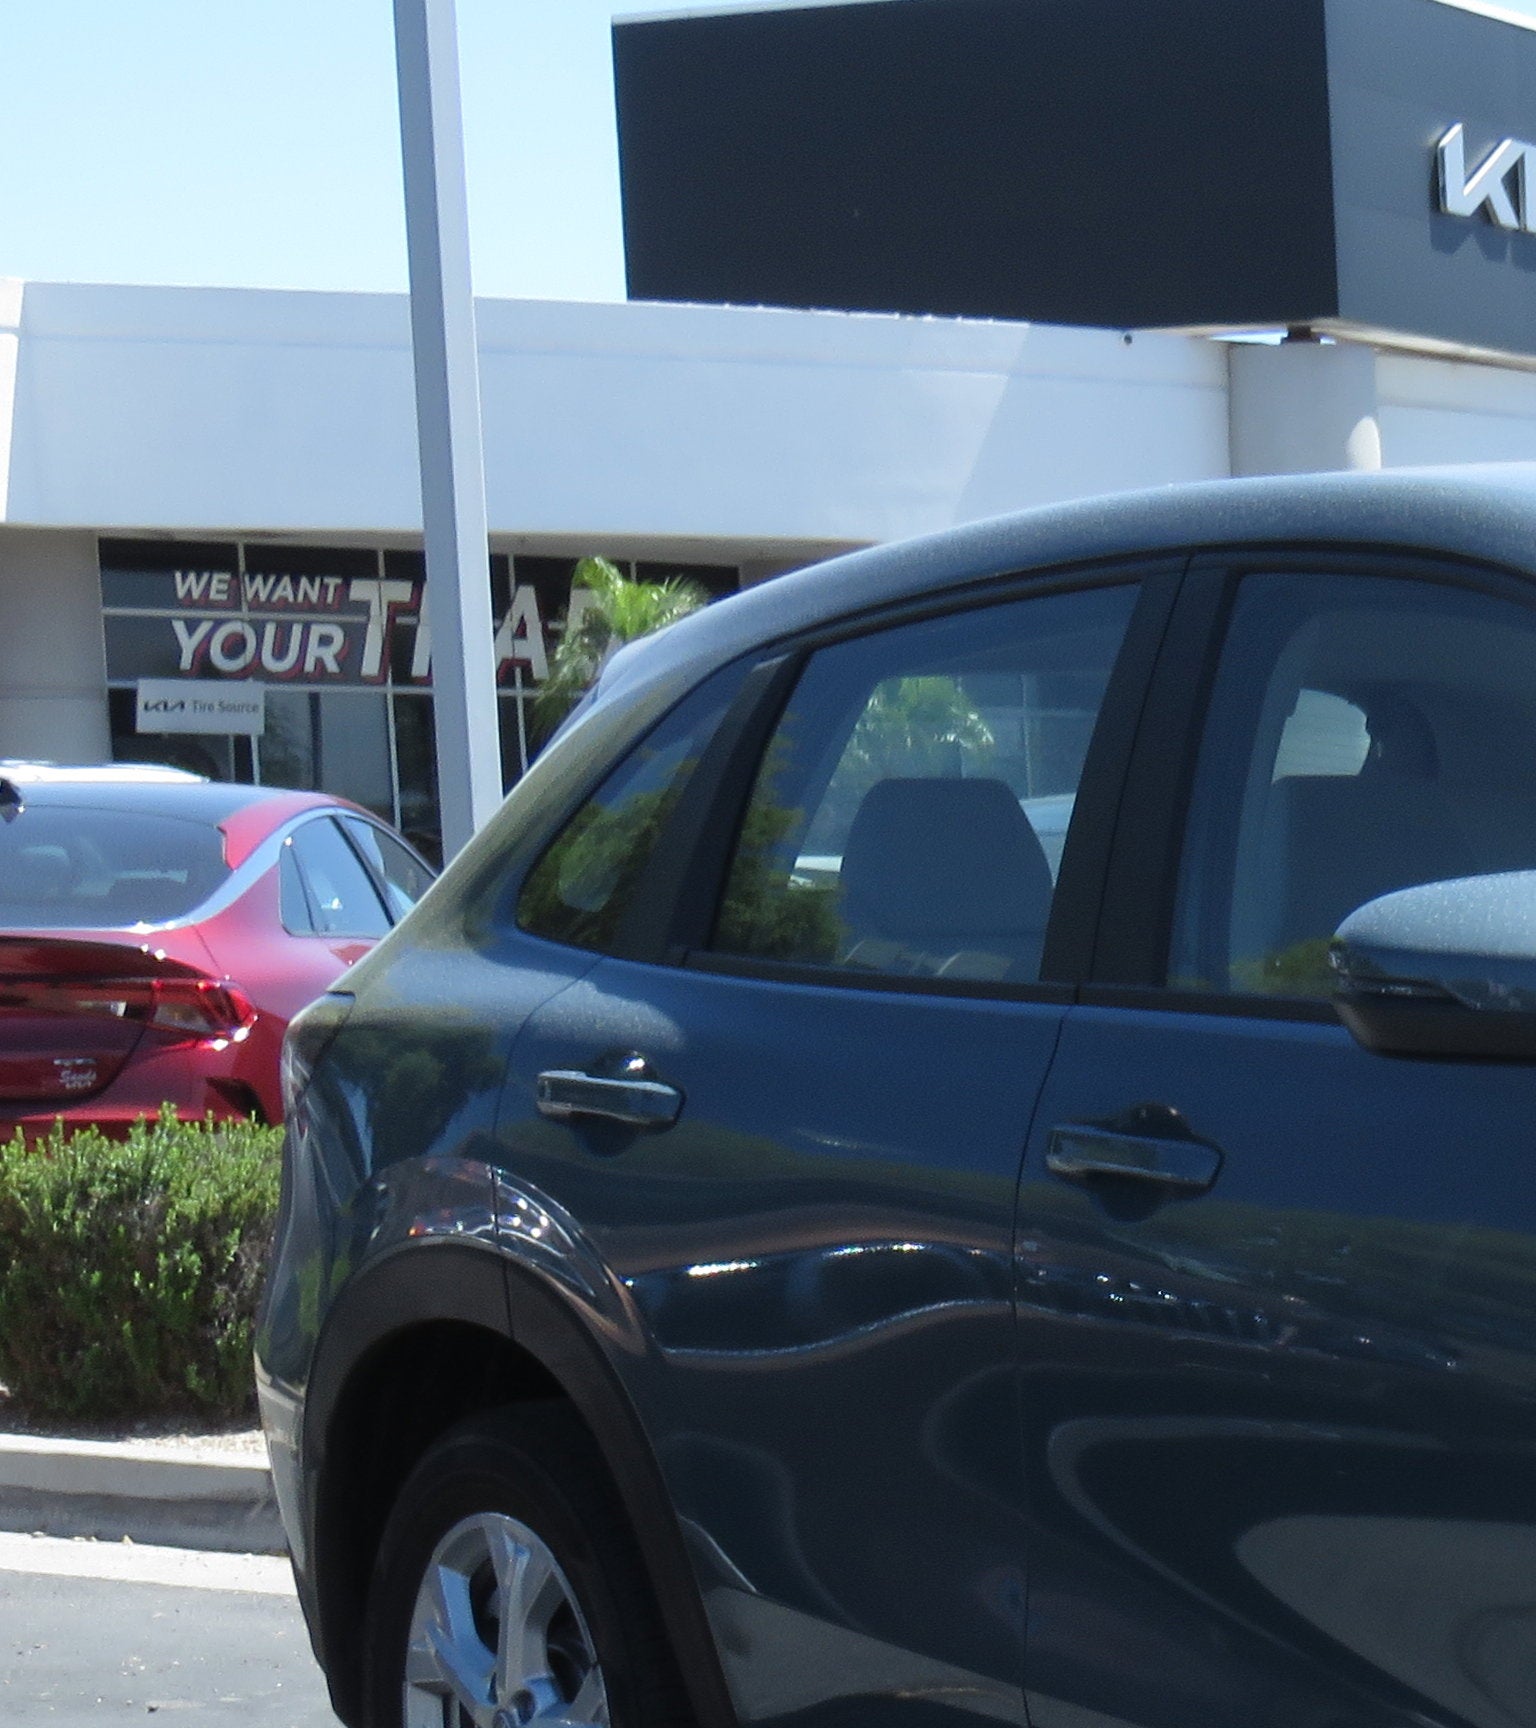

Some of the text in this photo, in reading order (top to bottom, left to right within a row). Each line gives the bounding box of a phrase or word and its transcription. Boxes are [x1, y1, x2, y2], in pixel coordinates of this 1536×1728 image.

[174, 571, 343, 605] WE WANT
[171, 618, 342, 674] YOUR
